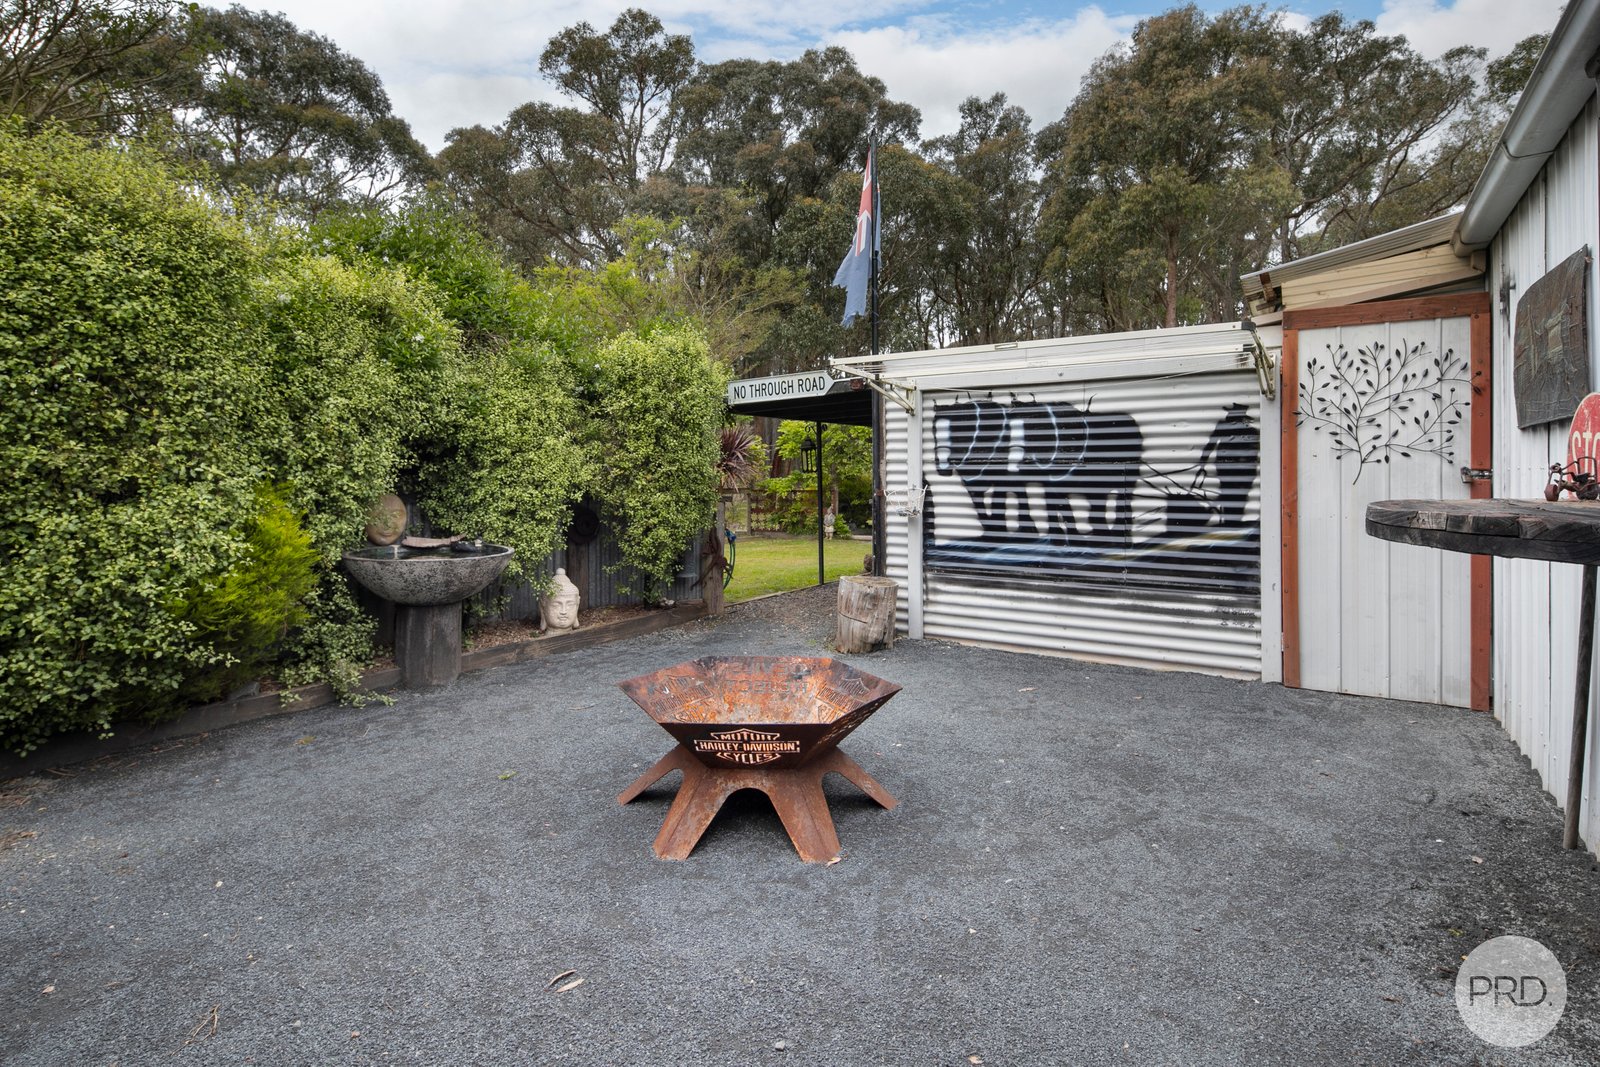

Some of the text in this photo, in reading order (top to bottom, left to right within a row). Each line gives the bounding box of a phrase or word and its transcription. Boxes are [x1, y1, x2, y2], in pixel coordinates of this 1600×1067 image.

[734, 376, 826, 399] NO THROUGH ROAD
[720, 731, 772, 741] MOTOR
[723, 752, 773, 764] CYCLES
